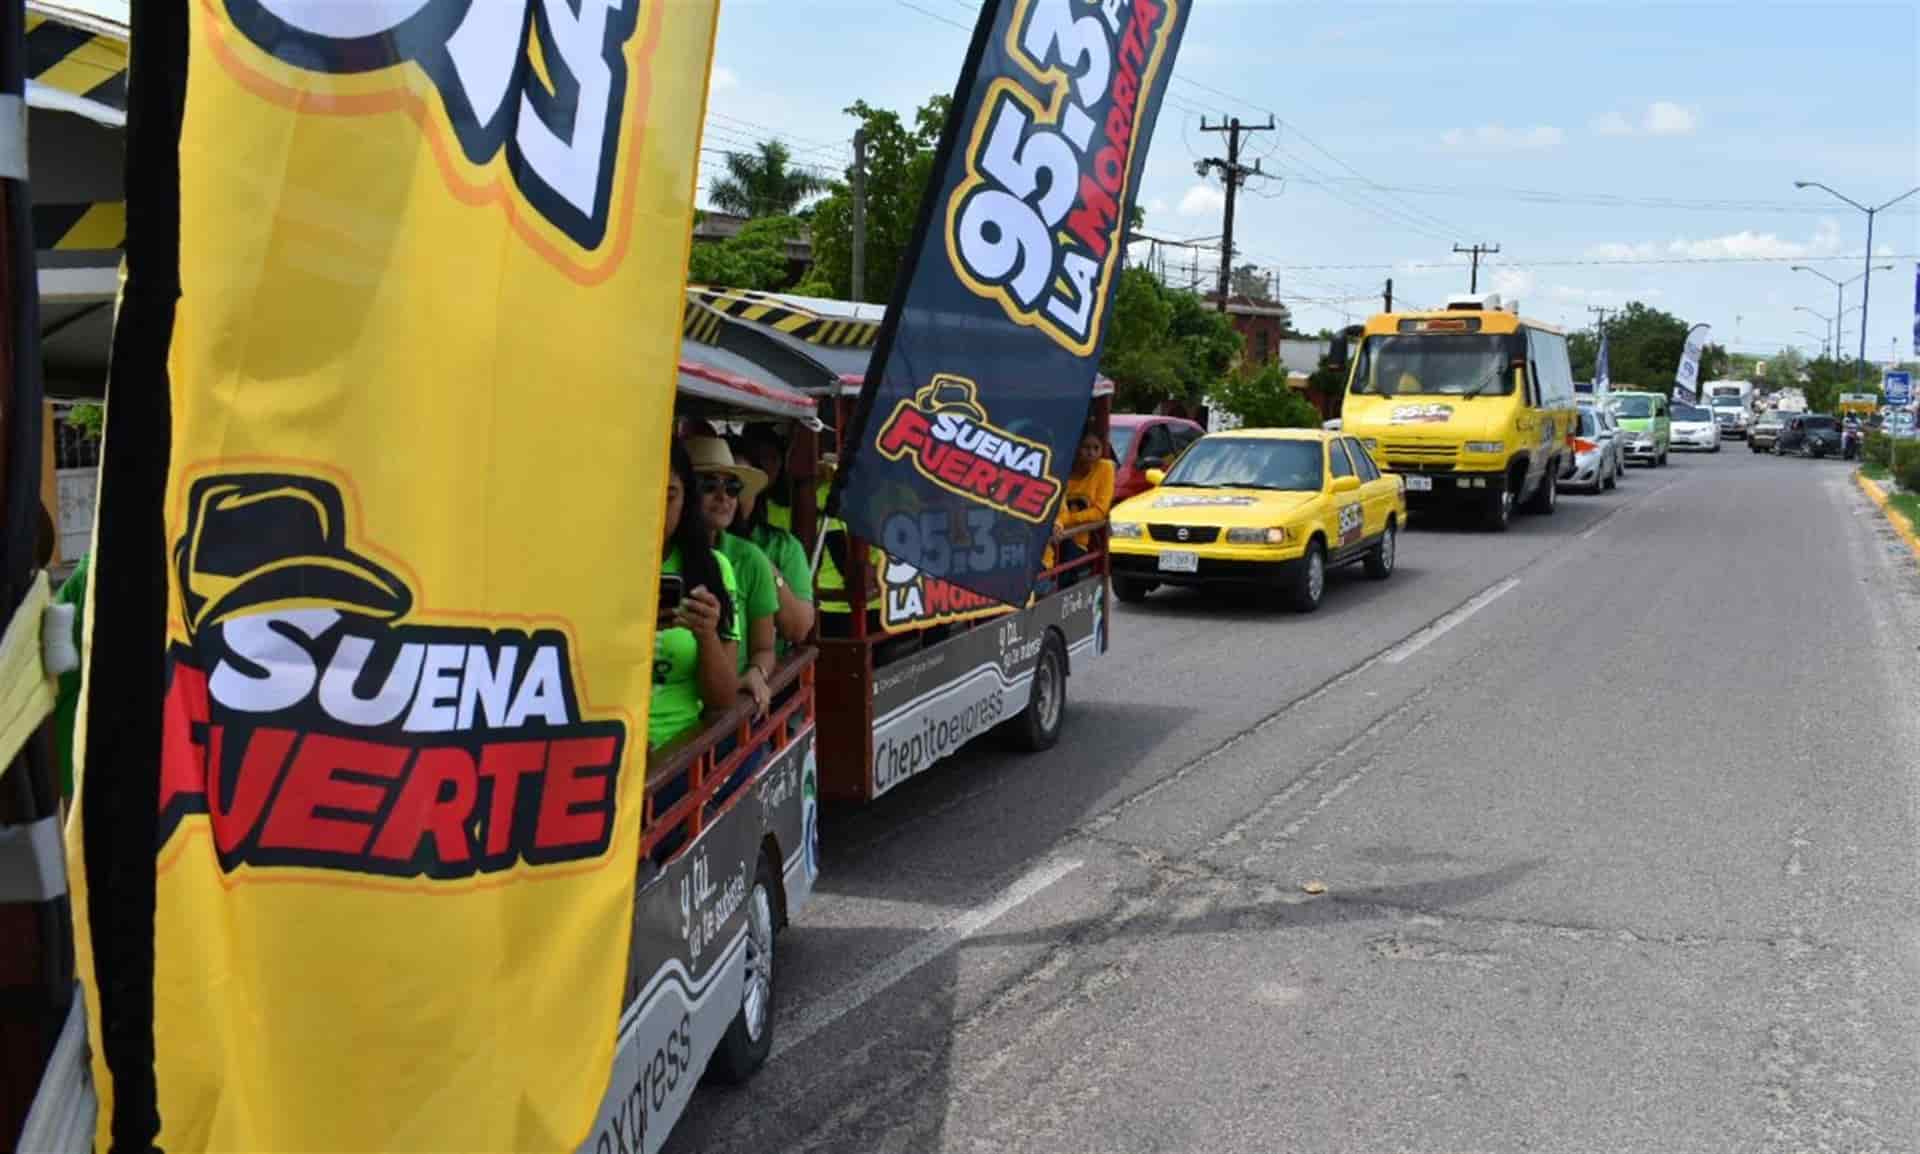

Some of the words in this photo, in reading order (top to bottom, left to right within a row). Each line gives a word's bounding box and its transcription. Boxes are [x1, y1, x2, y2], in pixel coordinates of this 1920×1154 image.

[1047, 252, 1099, 336] LA
[883, 408, 1055, 515] FUERTE
[931, 412, 1044, 477] SUENA
[889, 586, 924, 621] LA
[208, 608, 569, 733] SUENA
